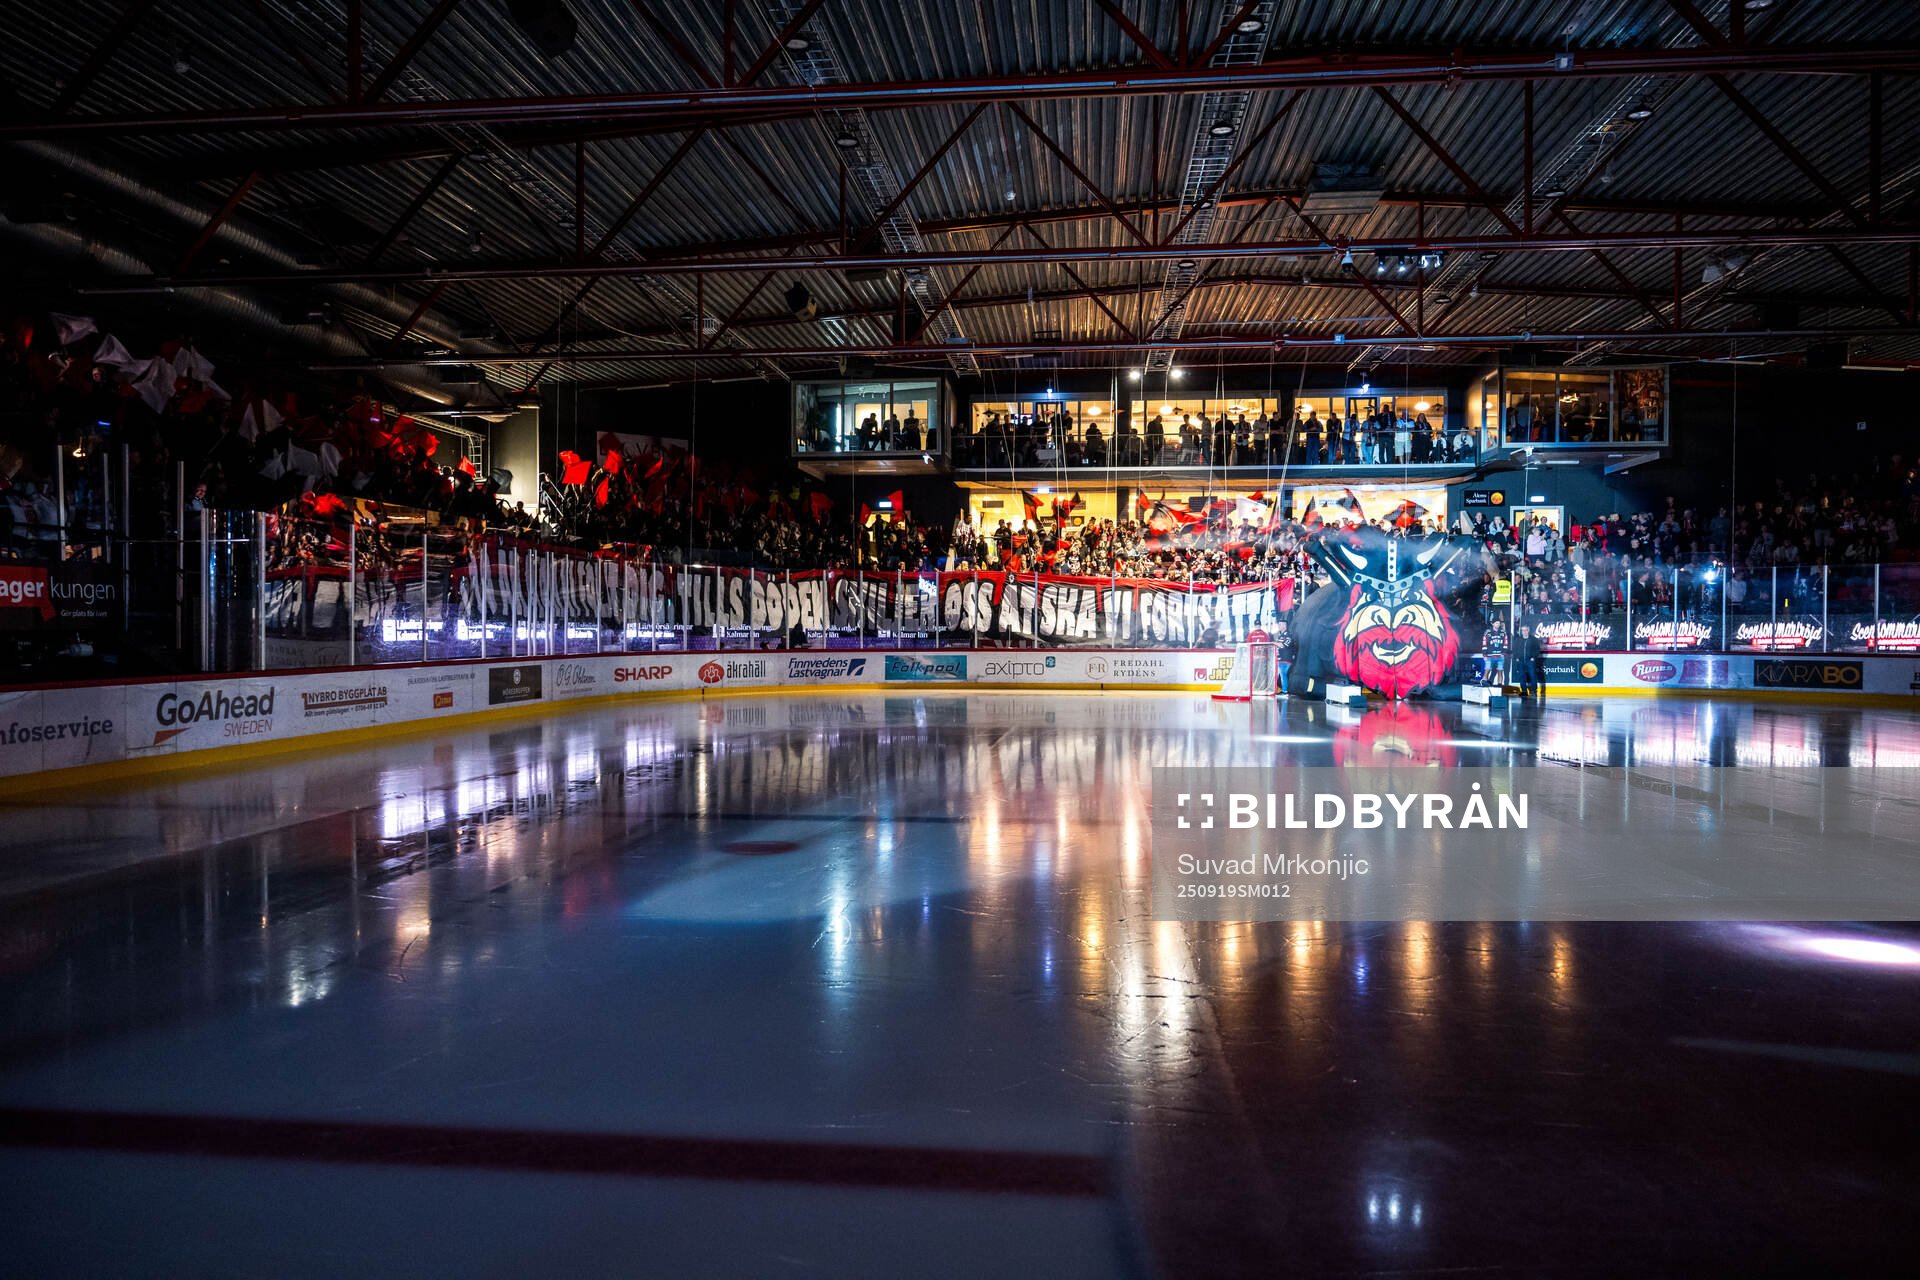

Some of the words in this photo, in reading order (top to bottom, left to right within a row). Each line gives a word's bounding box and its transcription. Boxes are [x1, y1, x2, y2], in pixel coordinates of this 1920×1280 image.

[51, 576, 115, 605] kungen
[676, 573, 745, 628] TILLS
[751, 573, 829, 631] DÖDEN
[943, 580, 993, 633] OSS
[999, 573, 1036, 635] ÅT
[1039, 584, 1097, 639] SKA
[1103, 589, 1133, 641] VI
[726, 660, 766, 678] åkrahäll
[788, 657, 848, 669] Finnvedens
[1113, 659, 1165, 667] FREDAHL
[614, 665, 673, 682] SHARP
[788, 667, 846, 679] Lastvagnar
[308, 691, 337, 703] NYBRO
[377, 686, 387, 696] AB
[156, 687, 275, 727] GoAhead
[223, 718, 273, 737] SWEDEN
